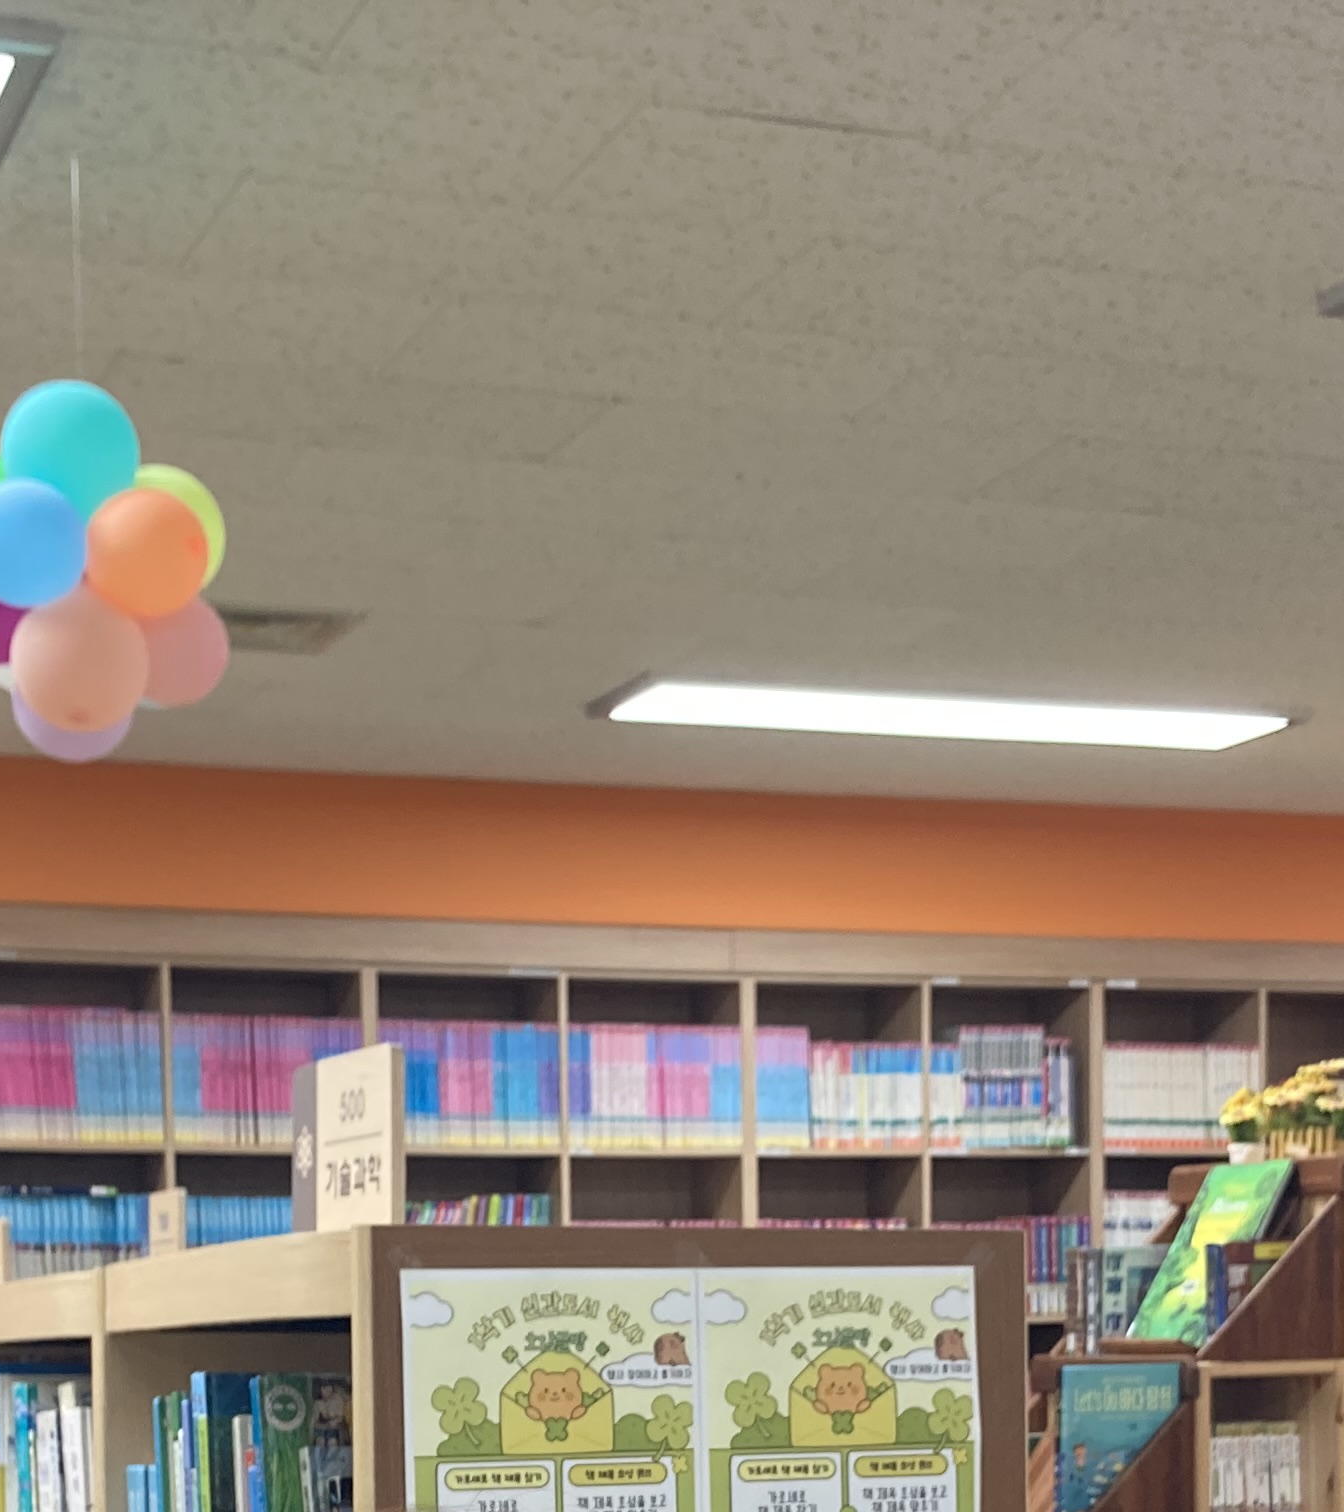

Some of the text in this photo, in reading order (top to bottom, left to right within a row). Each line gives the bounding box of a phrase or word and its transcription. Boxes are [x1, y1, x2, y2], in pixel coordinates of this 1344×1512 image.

[339, 1086, 366, 1123] 500
[325, 1154, 382, 1198] 기술과학
[520, 1291, 600, 1322] 신간도서
[607, 1304, 645, 1346] 행사
[888, 1301, 926, 1343] 행사
